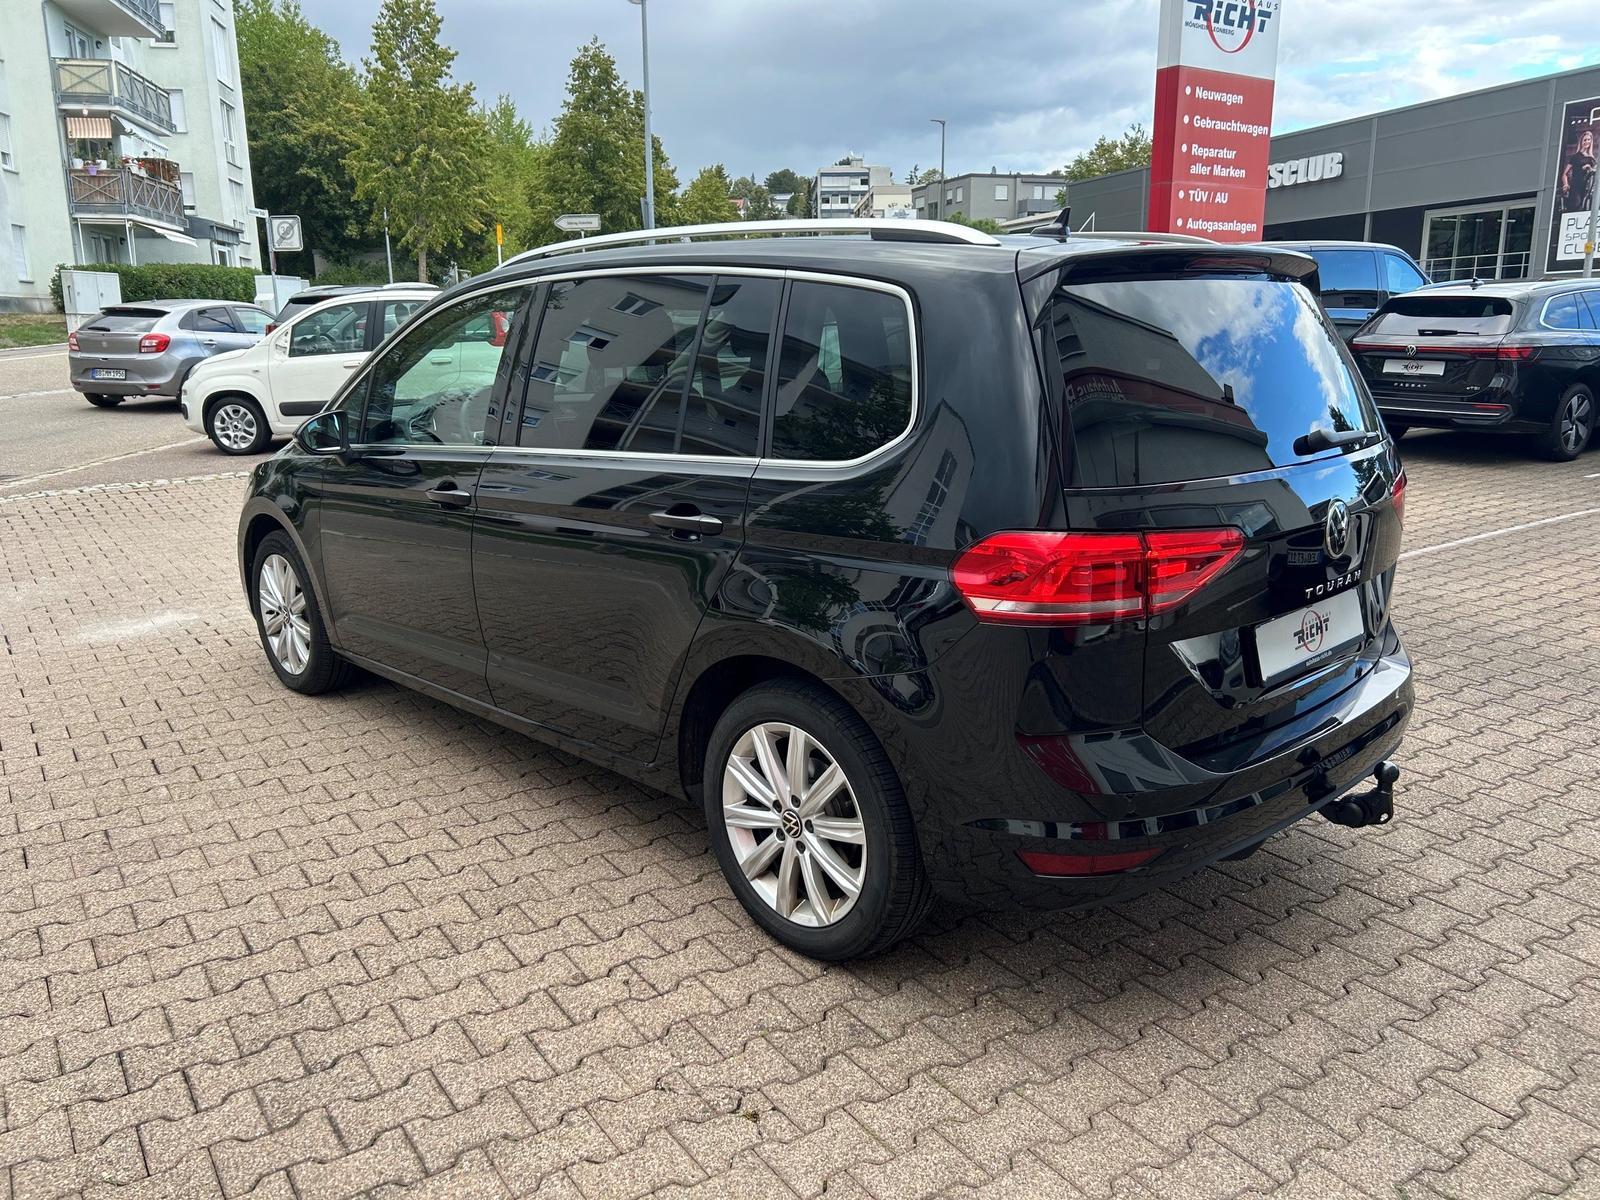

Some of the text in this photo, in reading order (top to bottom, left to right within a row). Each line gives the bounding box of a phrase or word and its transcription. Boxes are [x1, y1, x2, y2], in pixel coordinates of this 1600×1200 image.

[1195, 86, 1244, 106] Neuwagen
[1193, 115, 1269, 137] Gebrauchtwagen
[1191, 144, 1237, 159] Reparatur
[1190, 163, 1246, 178] aller Marken
[1267, 152, 1343, 188] SCLUB
[1188, 188, 1208, 203] TÜV
[1214, 192, 1228, 204] AU
[1186, 217, 1257, 235] Autogasanlagen
[1305, 569, 1361, 599] TOURAN
